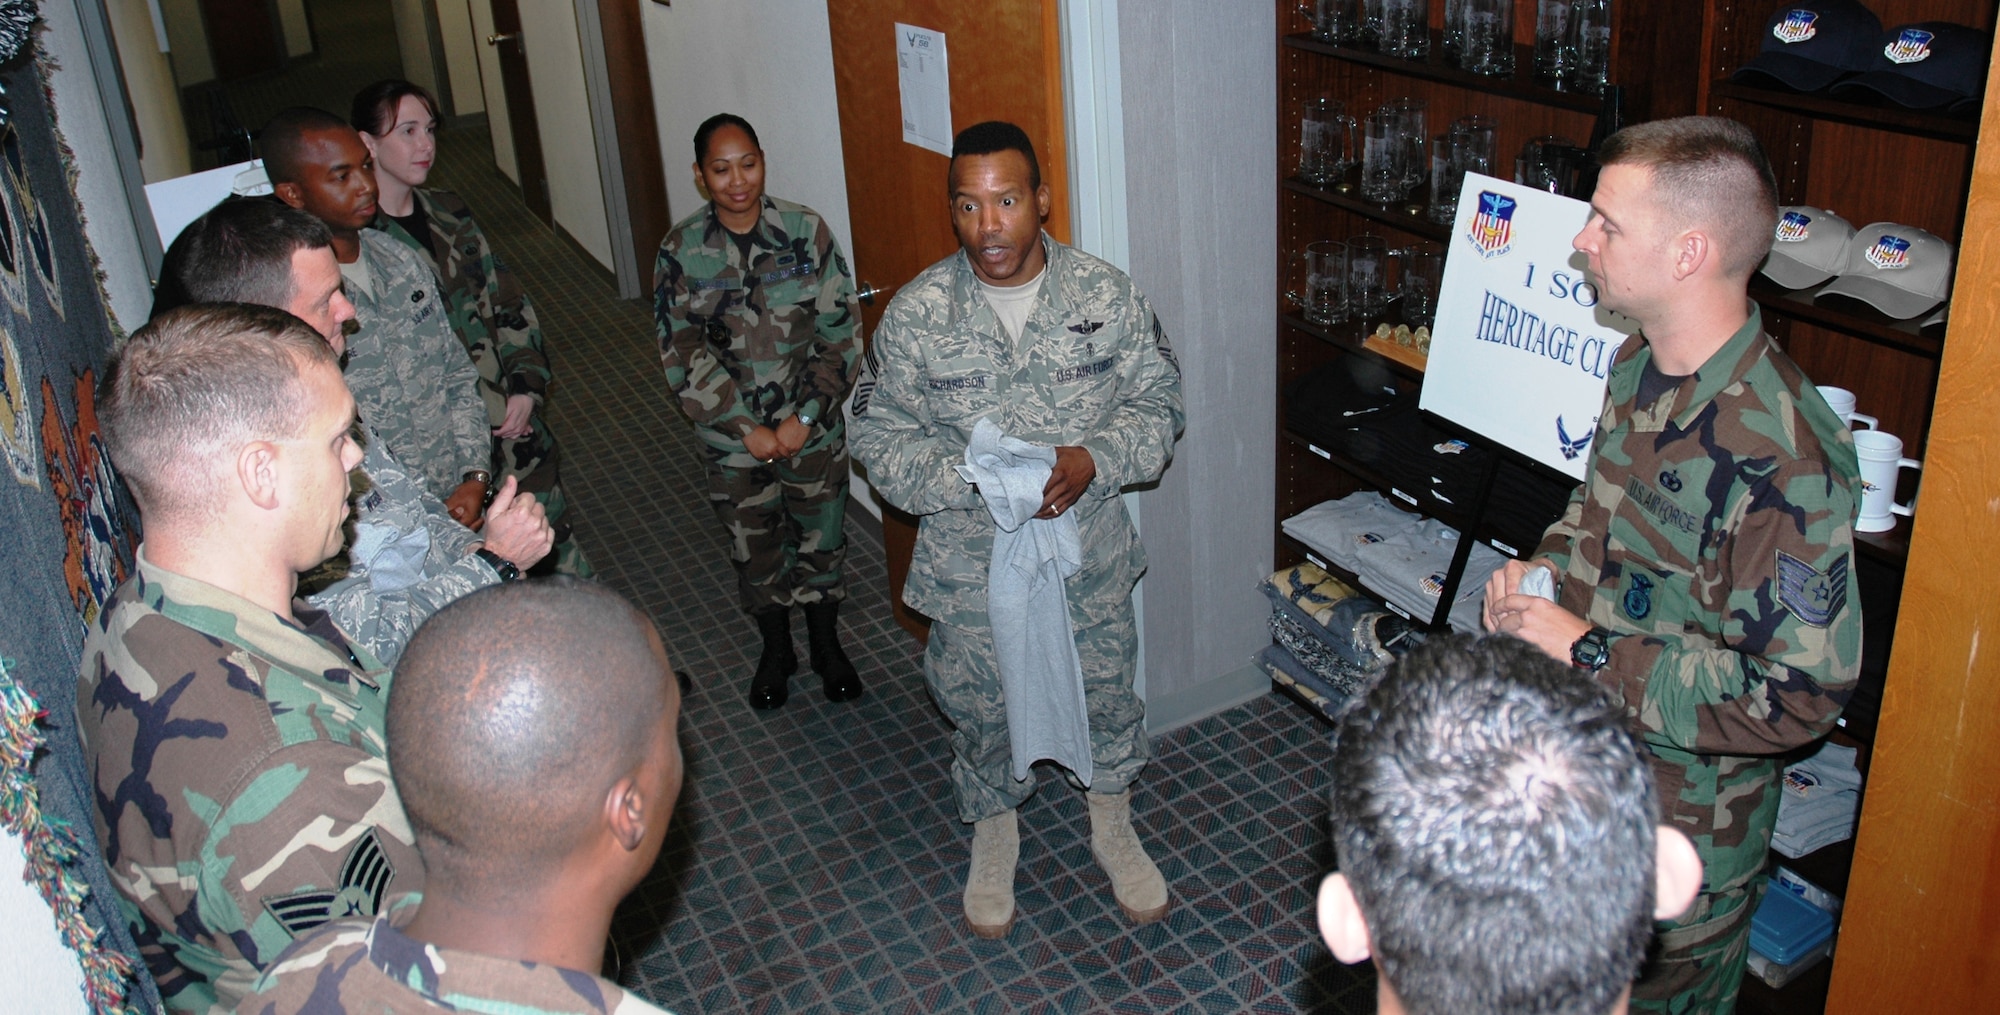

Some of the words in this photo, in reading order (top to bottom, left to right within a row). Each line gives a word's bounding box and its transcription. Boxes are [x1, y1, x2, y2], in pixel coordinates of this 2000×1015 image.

[1475, 288, 1579, 366] HERITAGE
[1076, 365, 1092, 379] AIR
[1644, 491, 1661, 514] AIR
[1658, 500, 1697, 533] FORCE
